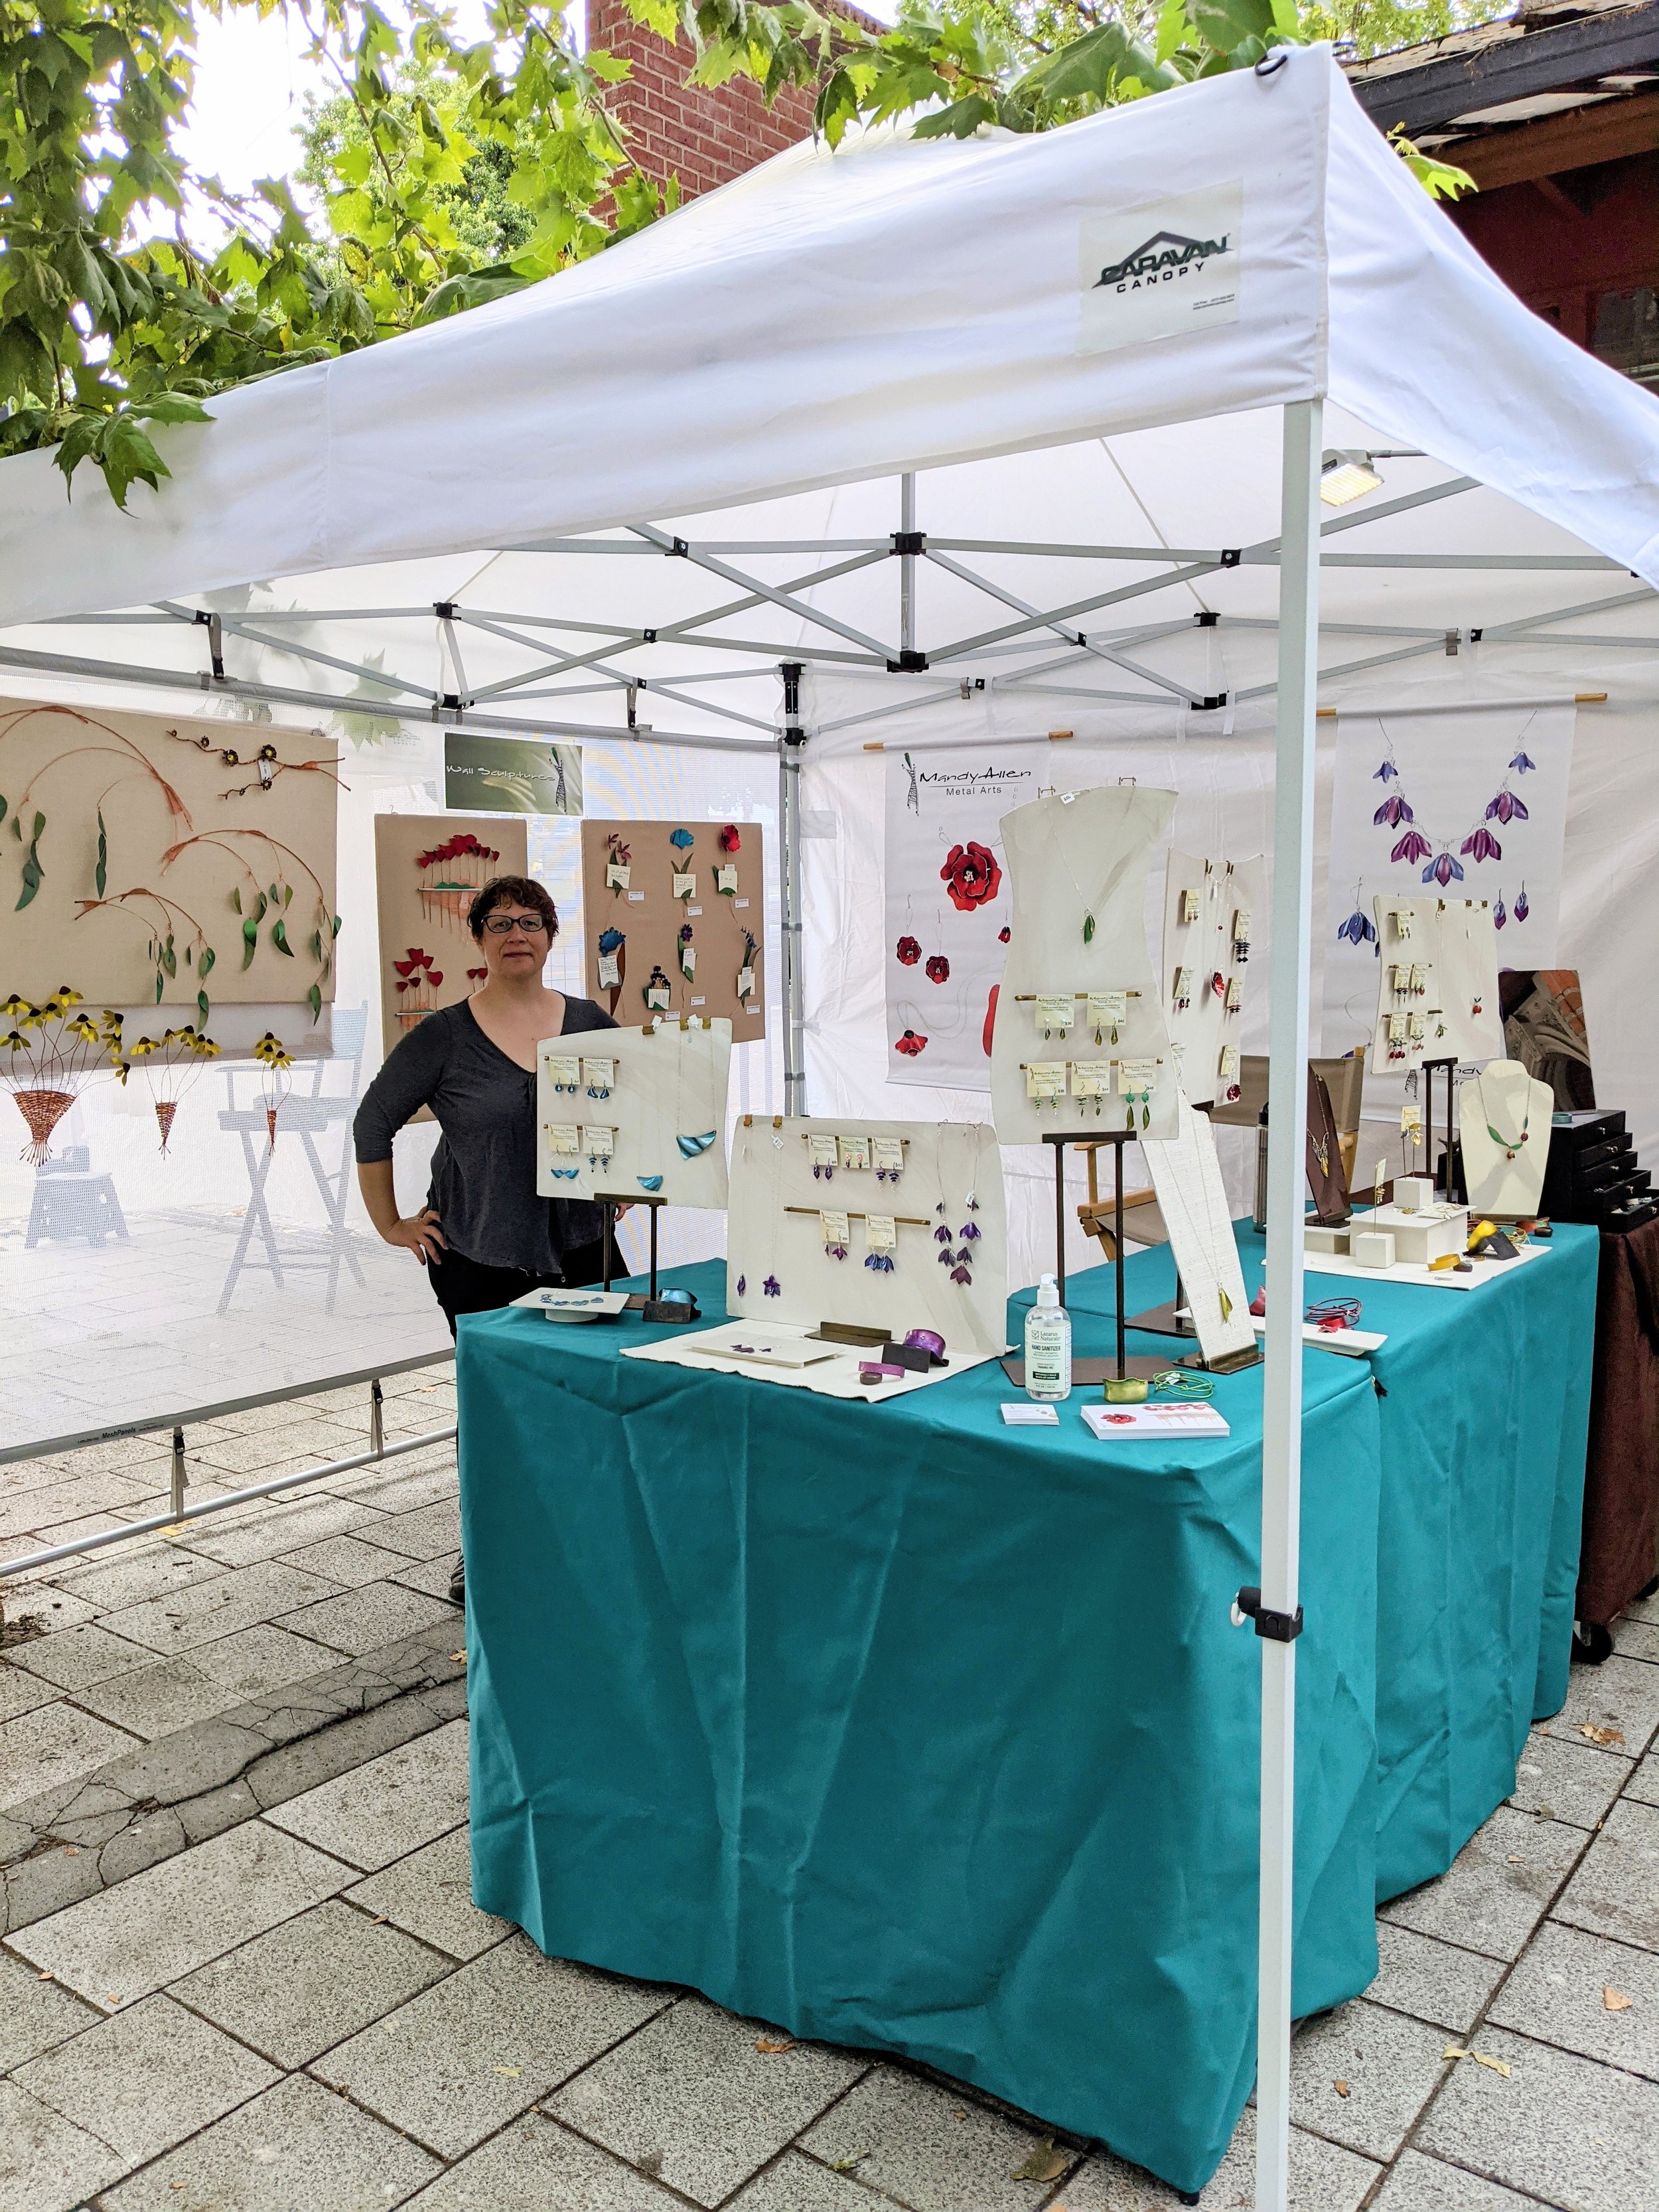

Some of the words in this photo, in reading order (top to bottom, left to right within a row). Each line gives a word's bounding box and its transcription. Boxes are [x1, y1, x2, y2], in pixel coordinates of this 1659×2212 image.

[1101, 236, 1228, 285] CARAVAN
[1116, 261, 1204, 293] CANOPY
[446, 765, 474, 775] Wall
[477, 767, 555, 780] Sculptures
[920, 771, 979, 784] Mandy
[978, 766, 1031, 779] Allen
[946, 787, 975, 796] Metal
[101, 1427, 137, 1439] MeshPanels
